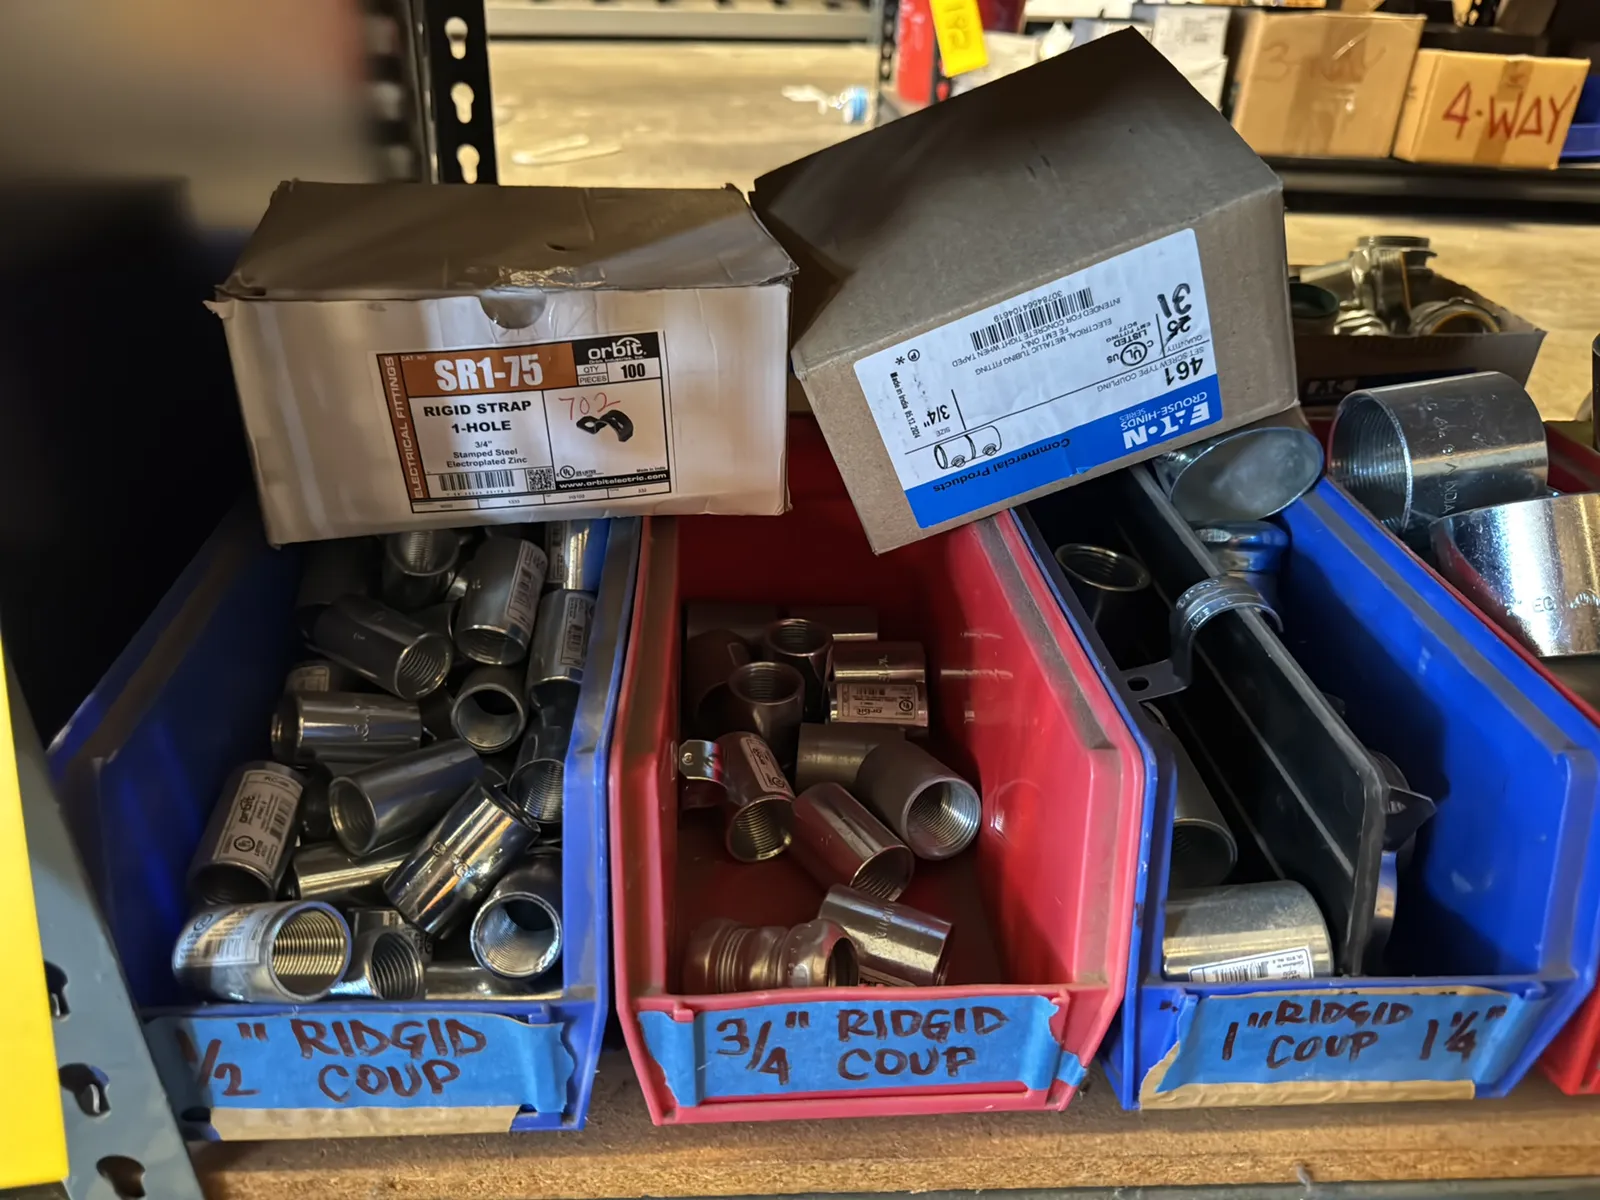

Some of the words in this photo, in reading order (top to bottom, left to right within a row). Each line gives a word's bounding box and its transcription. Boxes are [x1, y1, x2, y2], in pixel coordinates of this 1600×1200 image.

[1083, 297, 1121, 316] INTENDED
[1157, 283, 1192, 318] 31
[1066, 313, 1083, 325] FOR
[1067, 317, 1112, 338] ELECTRICAL
[1137, 321, 1151, 331] EMT
[1024, 318, 1065, 339] CONCRETE
[1042, 329, 1058, 342] EMT
[1059, 325, 1069, 335] FE
[1106, 327, 1135, 343] FITTING
[1001, 334, 1023, 347] TIGHT
[1021, 337, 1040, 350] ONLY
[1031, 334, 1067, 354] METALLIC
[1113, 329, 1147, 348] LISTED
[1167, 334, 1203, 352] QUANTITY
[588, 337, 643, 360] orbit
[979, 342, 1001, 357] WHEN
[1003, 348, 1031, 365] TUBING
[1189, 346, 1204, 356] SET
[952, 352, 978, 368] TAPED
[975, 359, 1003, 376] FITTING
[1160, 350, 1189, 368] SCREW
[434, 354, 543, 391] SR1-75
[579, 375, 607, 384] PIECES
[620, 363, 646, 379] 100
[1140, 363, 1161, 378] TYPE
[1164, 357, 1204, 386] 461
[384, 356, 406, 419] FITTINGS
[1097, 372, 1137, 392] COUPLING
[423, 404, 471, 417] RIGID
[477, 400, 532, 414] STRAP
[558, 392, 621, 420] 702
[1119, 408, 1147, 421] SERIES
[1120, 391, 1208, 431] CROUSE-HINDS
[923, 404, 950, 428] 3/4"
[451, 420, 512, 434] 1-HOLE
[935, 427, 950, 437] SIZE
[1122, 402, 1210, 450] EATON
[474, 440, 493, 449] 3/4"
[399, 422, 423, 499] ELECTRICAL
[446, 458, 506, 468] Electroplated
[508, 456, 527, 465] Zinc
[453, 450, 493, 460] Stamped
[495, 448, 518, 456] Steel
[994, 438, 1071, 472] Commercial
[559, 473, 667, 490] www.orbitelectric.com
[933, 467, 991, 492] Products
[1275, 999, 1413, 1028] RIDGID
[291, 1018, 487, 1059] RIDGID
[716, 1010, 810, 1086] 3/4"
[837, 1005, 1009, 1043] RIDGID
[1266, 1031, 1378, 1070] COUP
[837, 1046, 977, 1081] COUP
[318, 1059, 461, 1103] COUP
